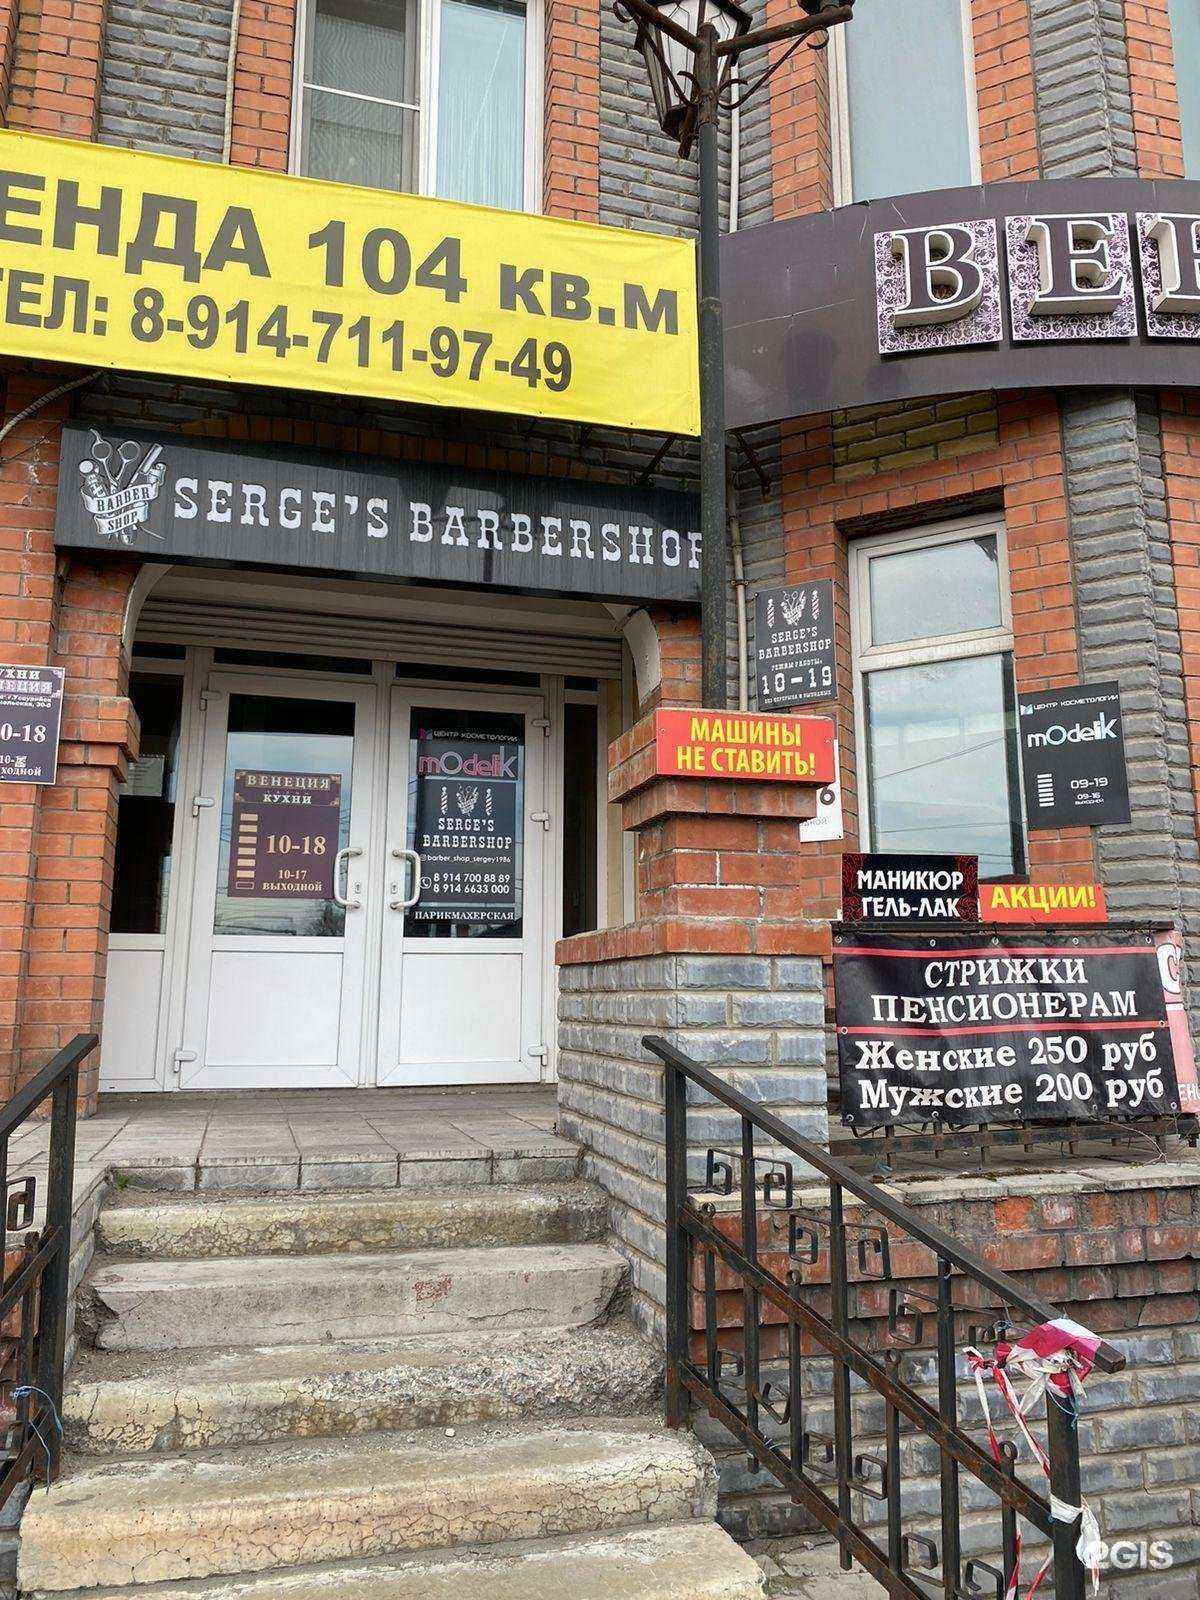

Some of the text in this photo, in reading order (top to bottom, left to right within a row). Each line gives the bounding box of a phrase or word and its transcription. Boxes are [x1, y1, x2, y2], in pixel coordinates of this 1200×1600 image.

[308, 218, 468, 304] 104
[0, 267, 573, 394] ЕЛ: 8-914-711-97-49
[97, 485, 150, 513] BARBER
[173, 477, 389, 538] SERGE'S
[108, 511, 138, 532] SHOP
[771, 626, 818, 644] SERGE'S
[758, 638, 832, 660] BARBERSHOP
[1060, 694, 1119, 707] КОСМЕТОЛОГИИ
[690, 717, 801, 747] МАШИНЫ
[676, 746, 816, 776] НЕ СТАВИТЬ!
[247, 775, 329, 789] ВЕНЕЦИЯ
[1071, 777, 1109, 788] 09-19
[263, 793, 312, 804] КУХНИ
[438, 817, 495, 832] SERGE'S
[265, 834, 327, 855] 10-18
[422, 834, 512, 850] BARBERSHOP
[278, 869, 308, 880] 10-17
[433, 872, 440, 882] 8
[442, 873, 461, 882] 914
[464, 873, 482, 883] 700
[483, 873, 496, 883] 88
[857, 870, 964, 891] МАНИКЮР
[262, 881, 322, 892] ВЫХОДНОЙ
[433, 883, 510, 894] 8 914 6633 000
[861, 897, 962, 918] ГЕЛЬ-ЛАК
[991, 885, 1097, 914] АКЦИИ!
[414, 911, 514, 920] ПАРИКМАХЕРСКАЯ
[924, 958, 1089, 989] СТРИЖКИ
[870, 990, 1139, 1025] ПЕНСИОНЕРАМ
[854, 1032, 1157, 1073] Женские 250 руб
[858, 1068, 1164, 1116] Мужские 200 руб
